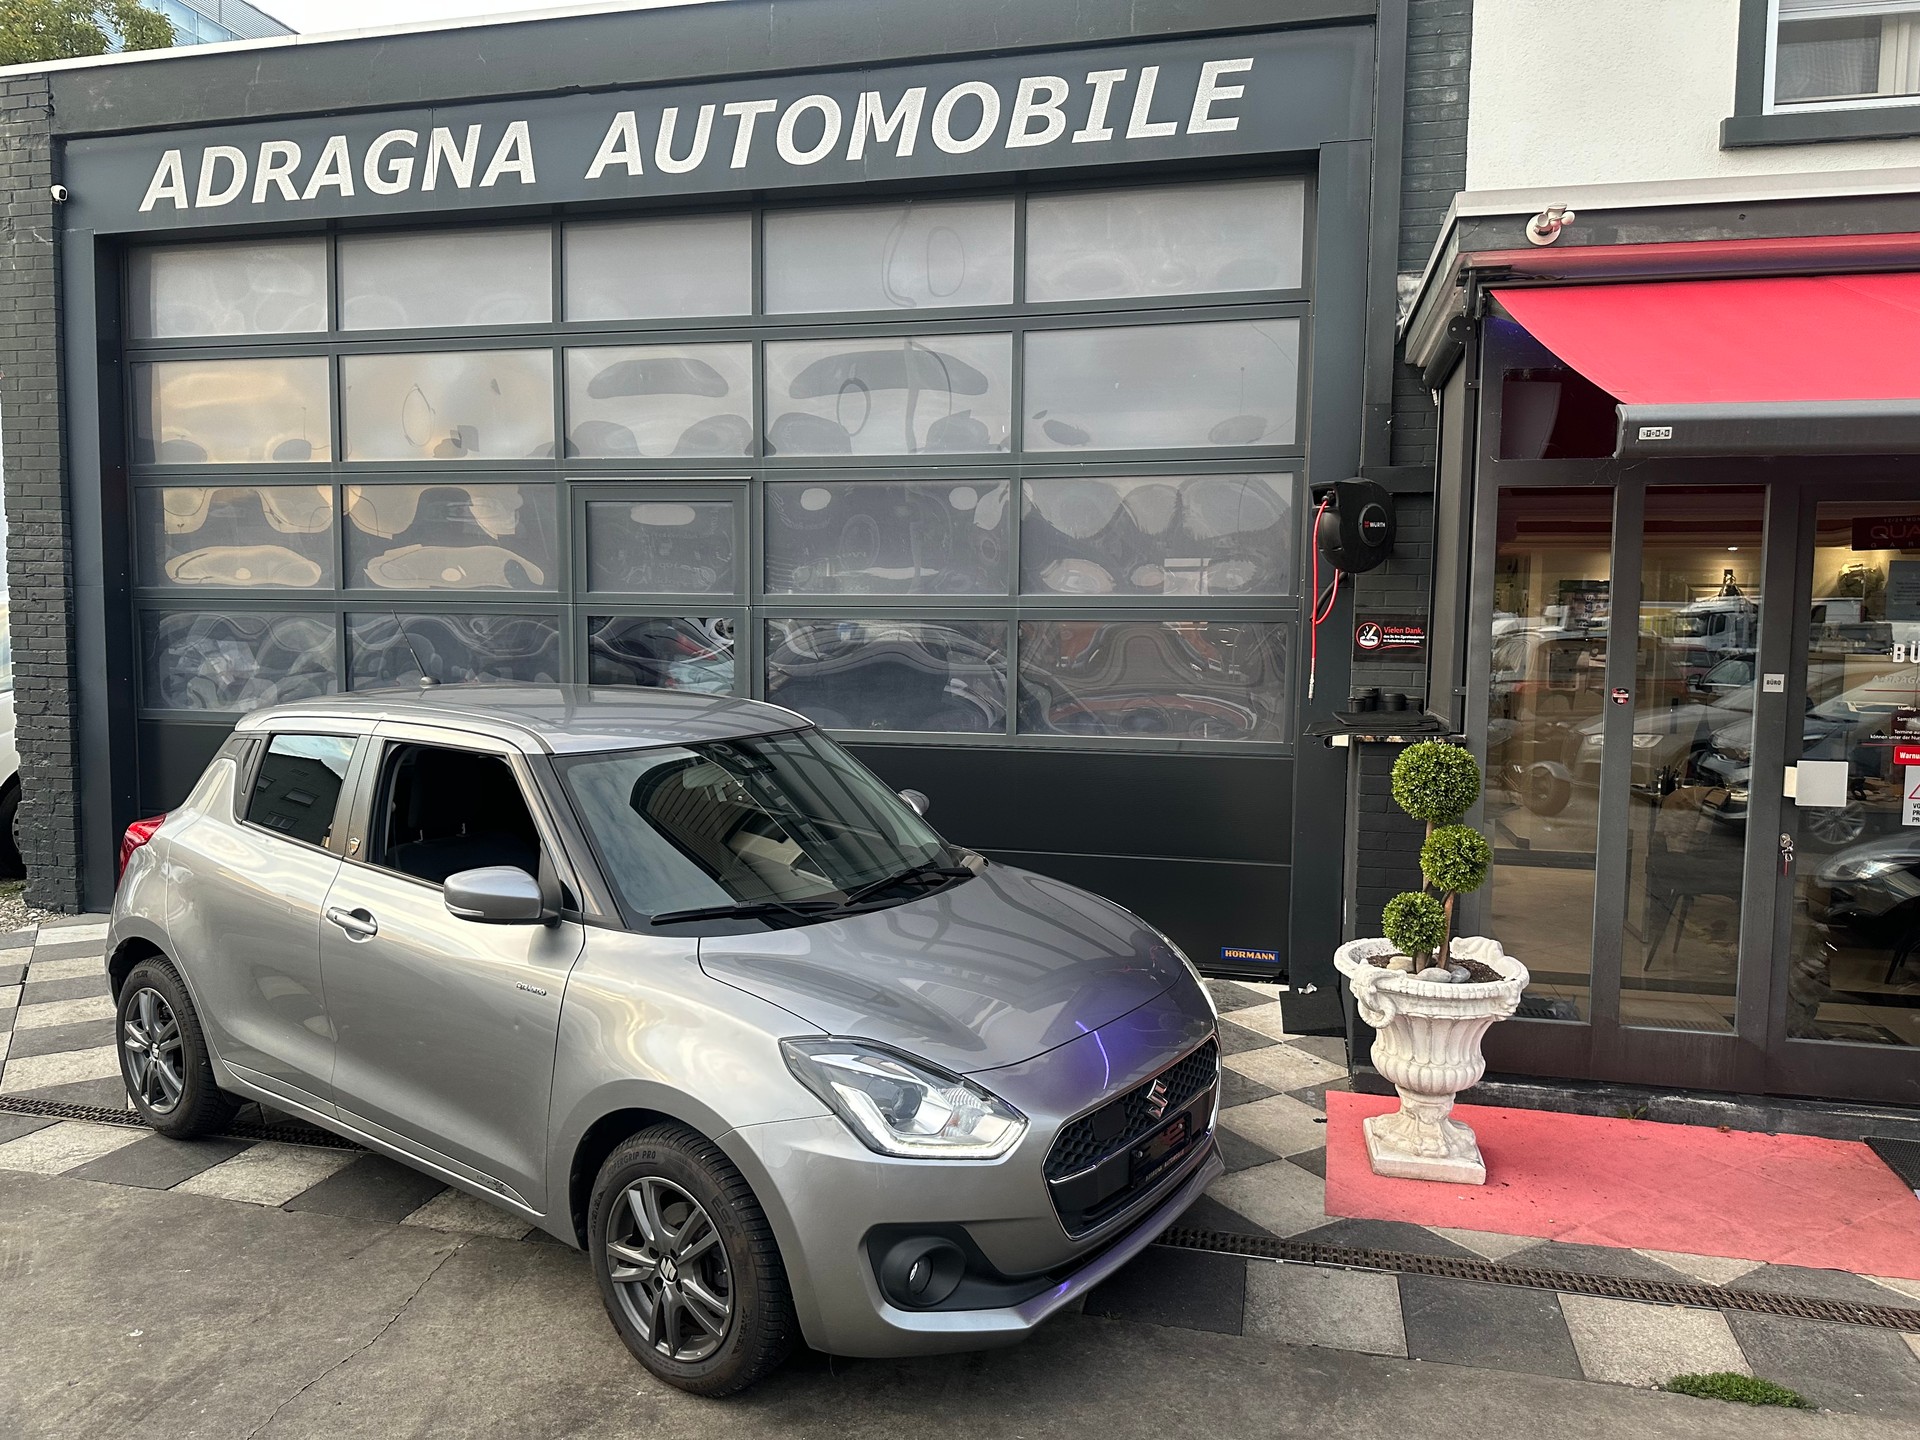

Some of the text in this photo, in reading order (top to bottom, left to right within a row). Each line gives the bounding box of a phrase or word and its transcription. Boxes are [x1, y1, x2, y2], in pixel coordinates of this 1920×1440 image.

[138, 57, 1254, 213] ADRAGNA AUTOMOBILE
[1383, 626, 1424, 635] Vielen Dank,
[1225, 949, 1276, 961] HÖRMANN
[606, 1150, 657, 1178] SUPERGRIP PRO
